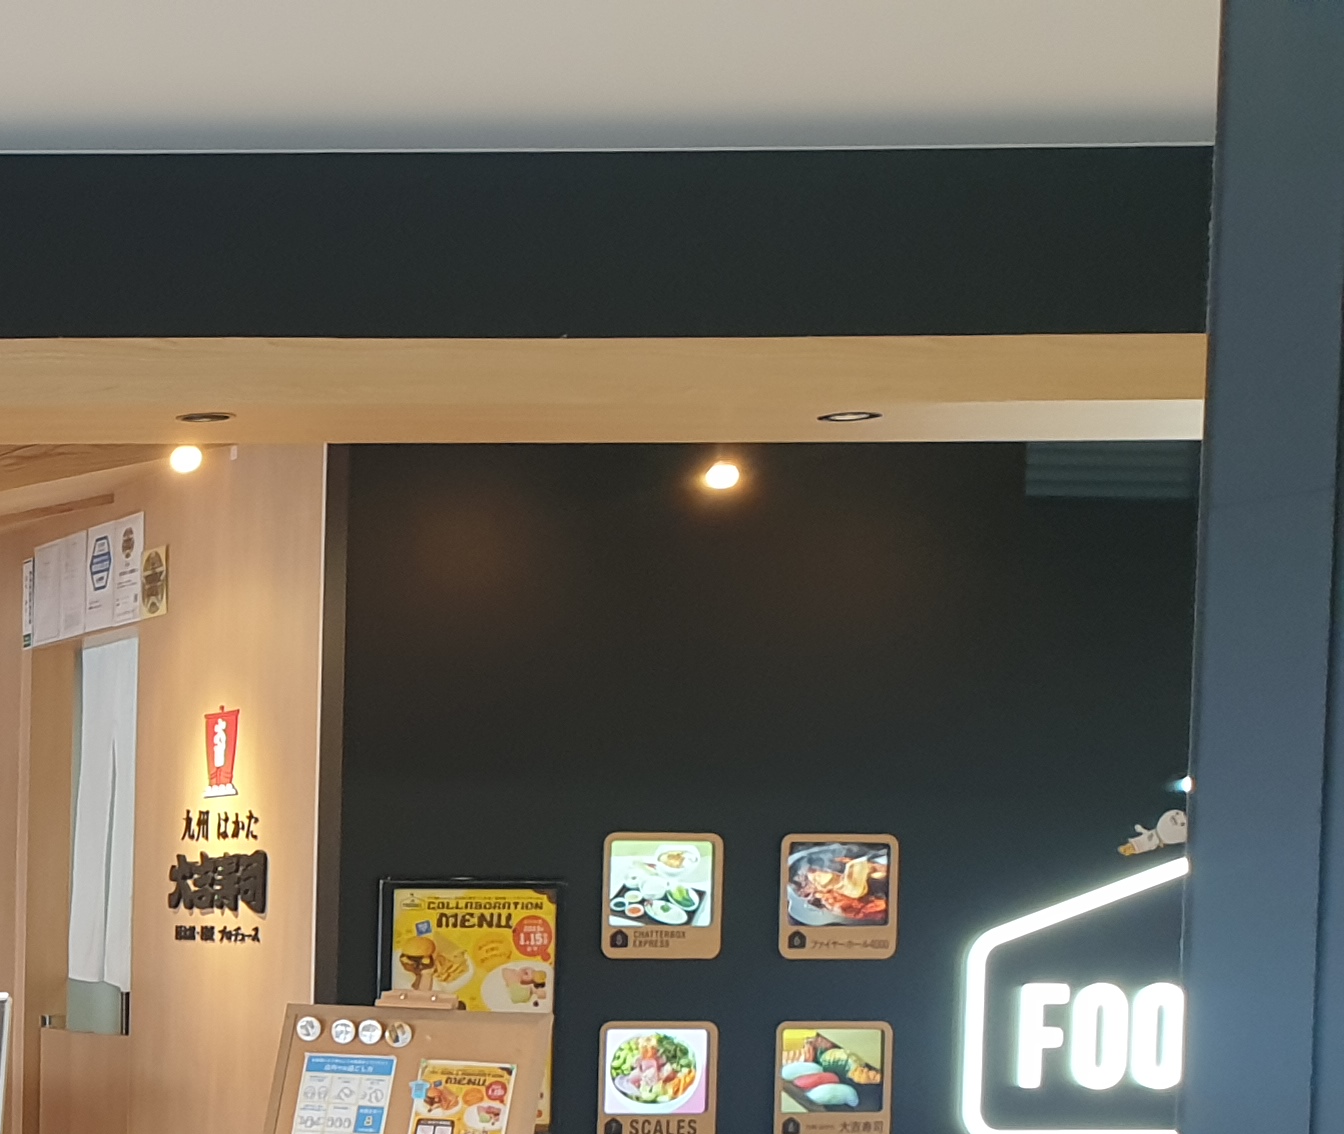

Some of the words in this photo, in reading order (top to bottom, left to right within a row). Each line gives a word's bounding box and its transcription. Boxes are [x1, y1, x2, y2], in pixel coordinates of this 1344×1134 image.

[180, 809, 210, 842] 九州
[216, 809, 260, 842] はかた
[427, 900, 544, 911] COLLABORATION
[436, 912, 513, 929] MENU
[445, 1076, 487, 1086] MENU
